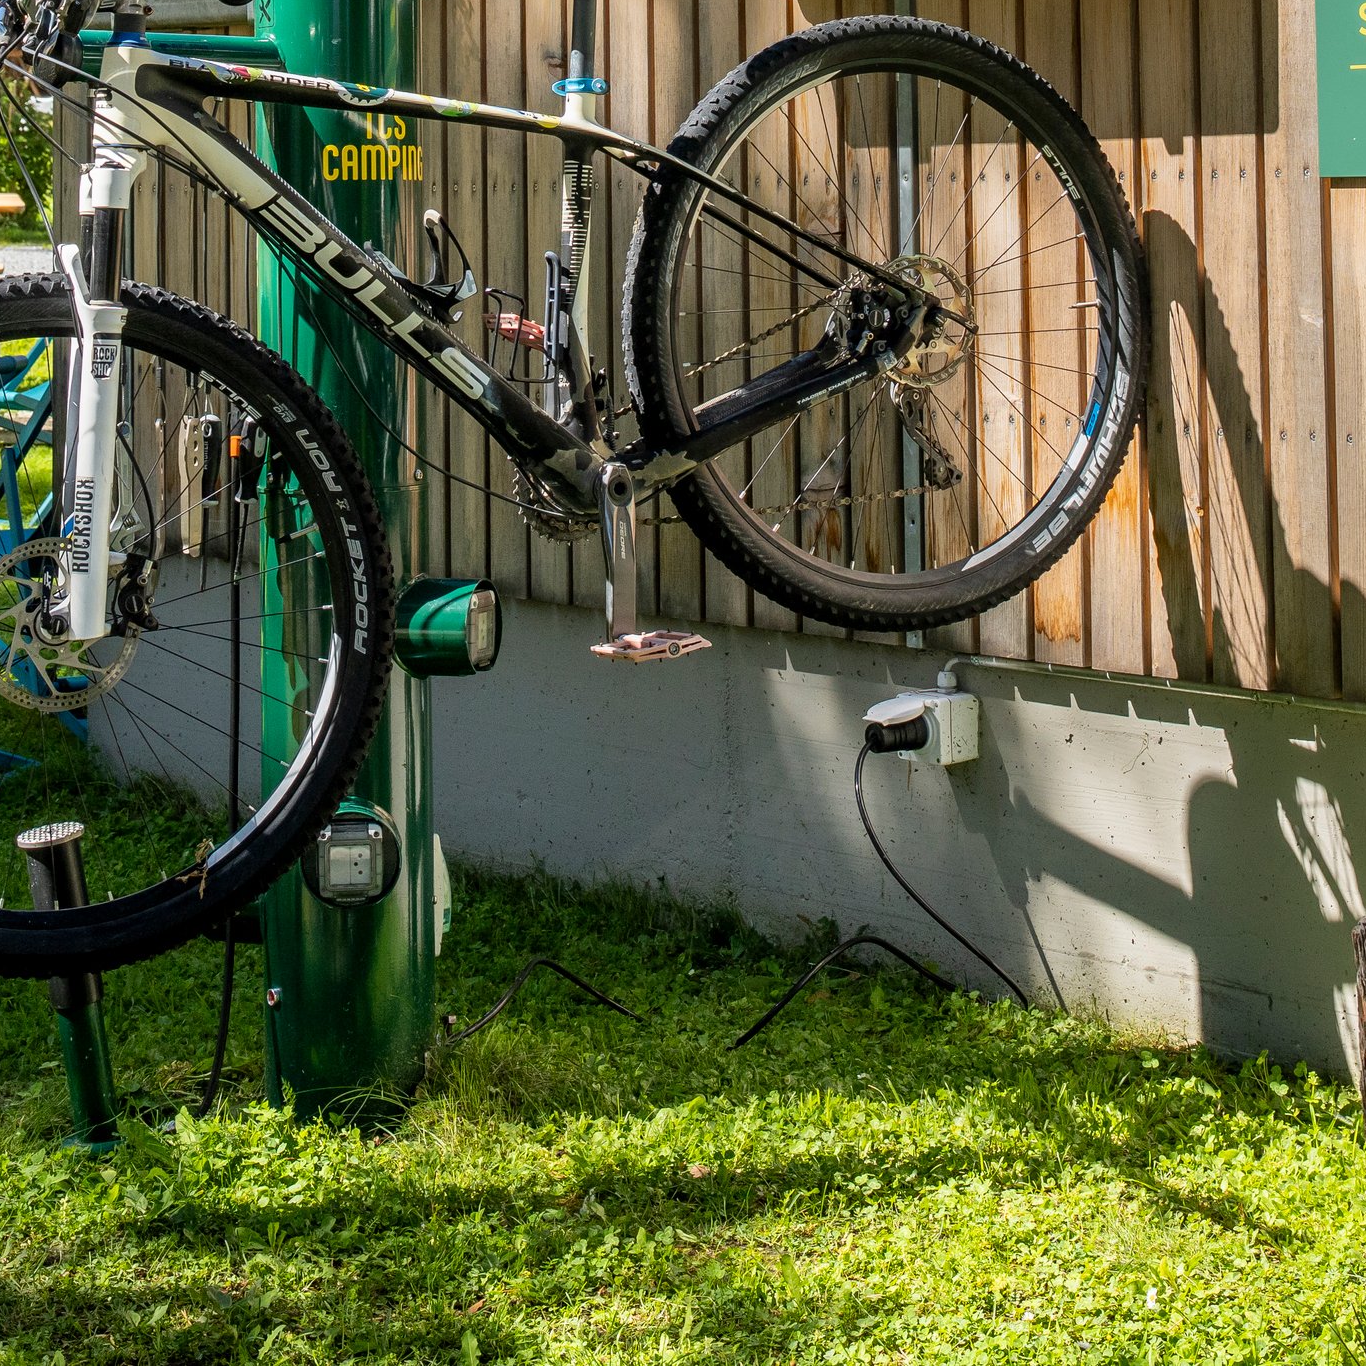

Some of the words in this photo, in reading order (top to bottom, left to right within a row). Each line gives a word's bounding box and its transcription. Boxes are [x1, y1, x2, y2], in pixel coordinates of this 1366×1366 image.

[322, 144, 423, 182] CAMPING
[1041, 144, 1081, 200] BULLS
[258, 195, 492, 400] BULLS
[93, 347, 116, 361] ROCK
[199, 369, 263, 420] BULLS
[295, 429, 343, 493] RON
[1032, 370, 1130, 554] SCHWALBE
[71, 478, 95, 573] ROCKSHOX
[339, 516, 369, 655] ROCKET
